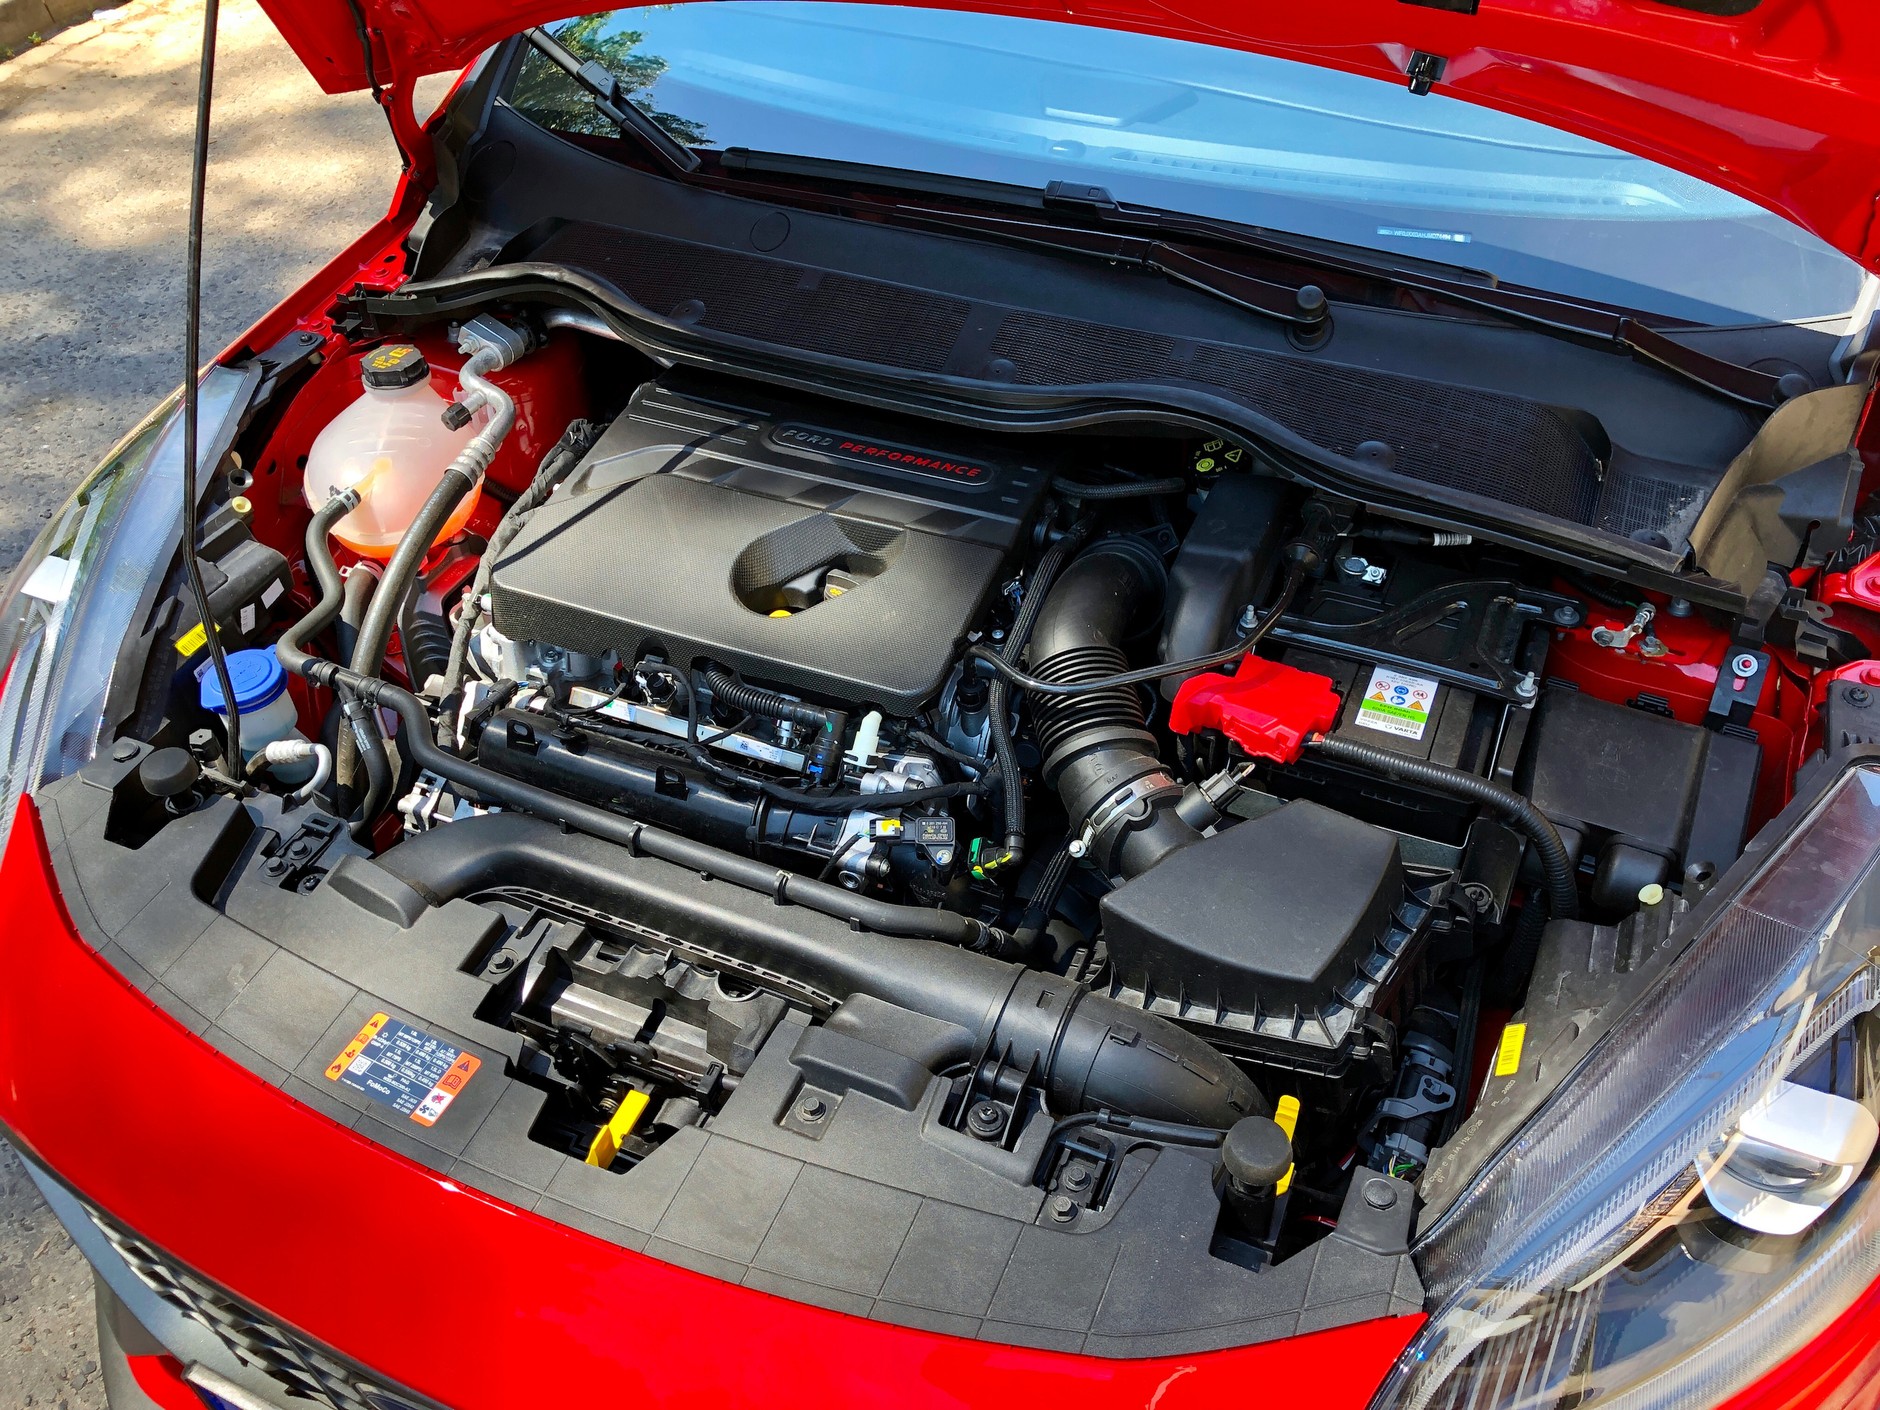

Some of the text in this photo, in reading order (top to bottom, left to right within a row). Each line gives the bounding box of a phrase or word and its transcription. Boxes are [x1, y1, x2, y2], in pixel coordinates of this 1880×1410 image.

[781, 429, 982, 477] FORD PERFORMANCE
[1394, 727, 1418, 735] VARTA
[366, 1079, 391, 1095] FoMoCo
